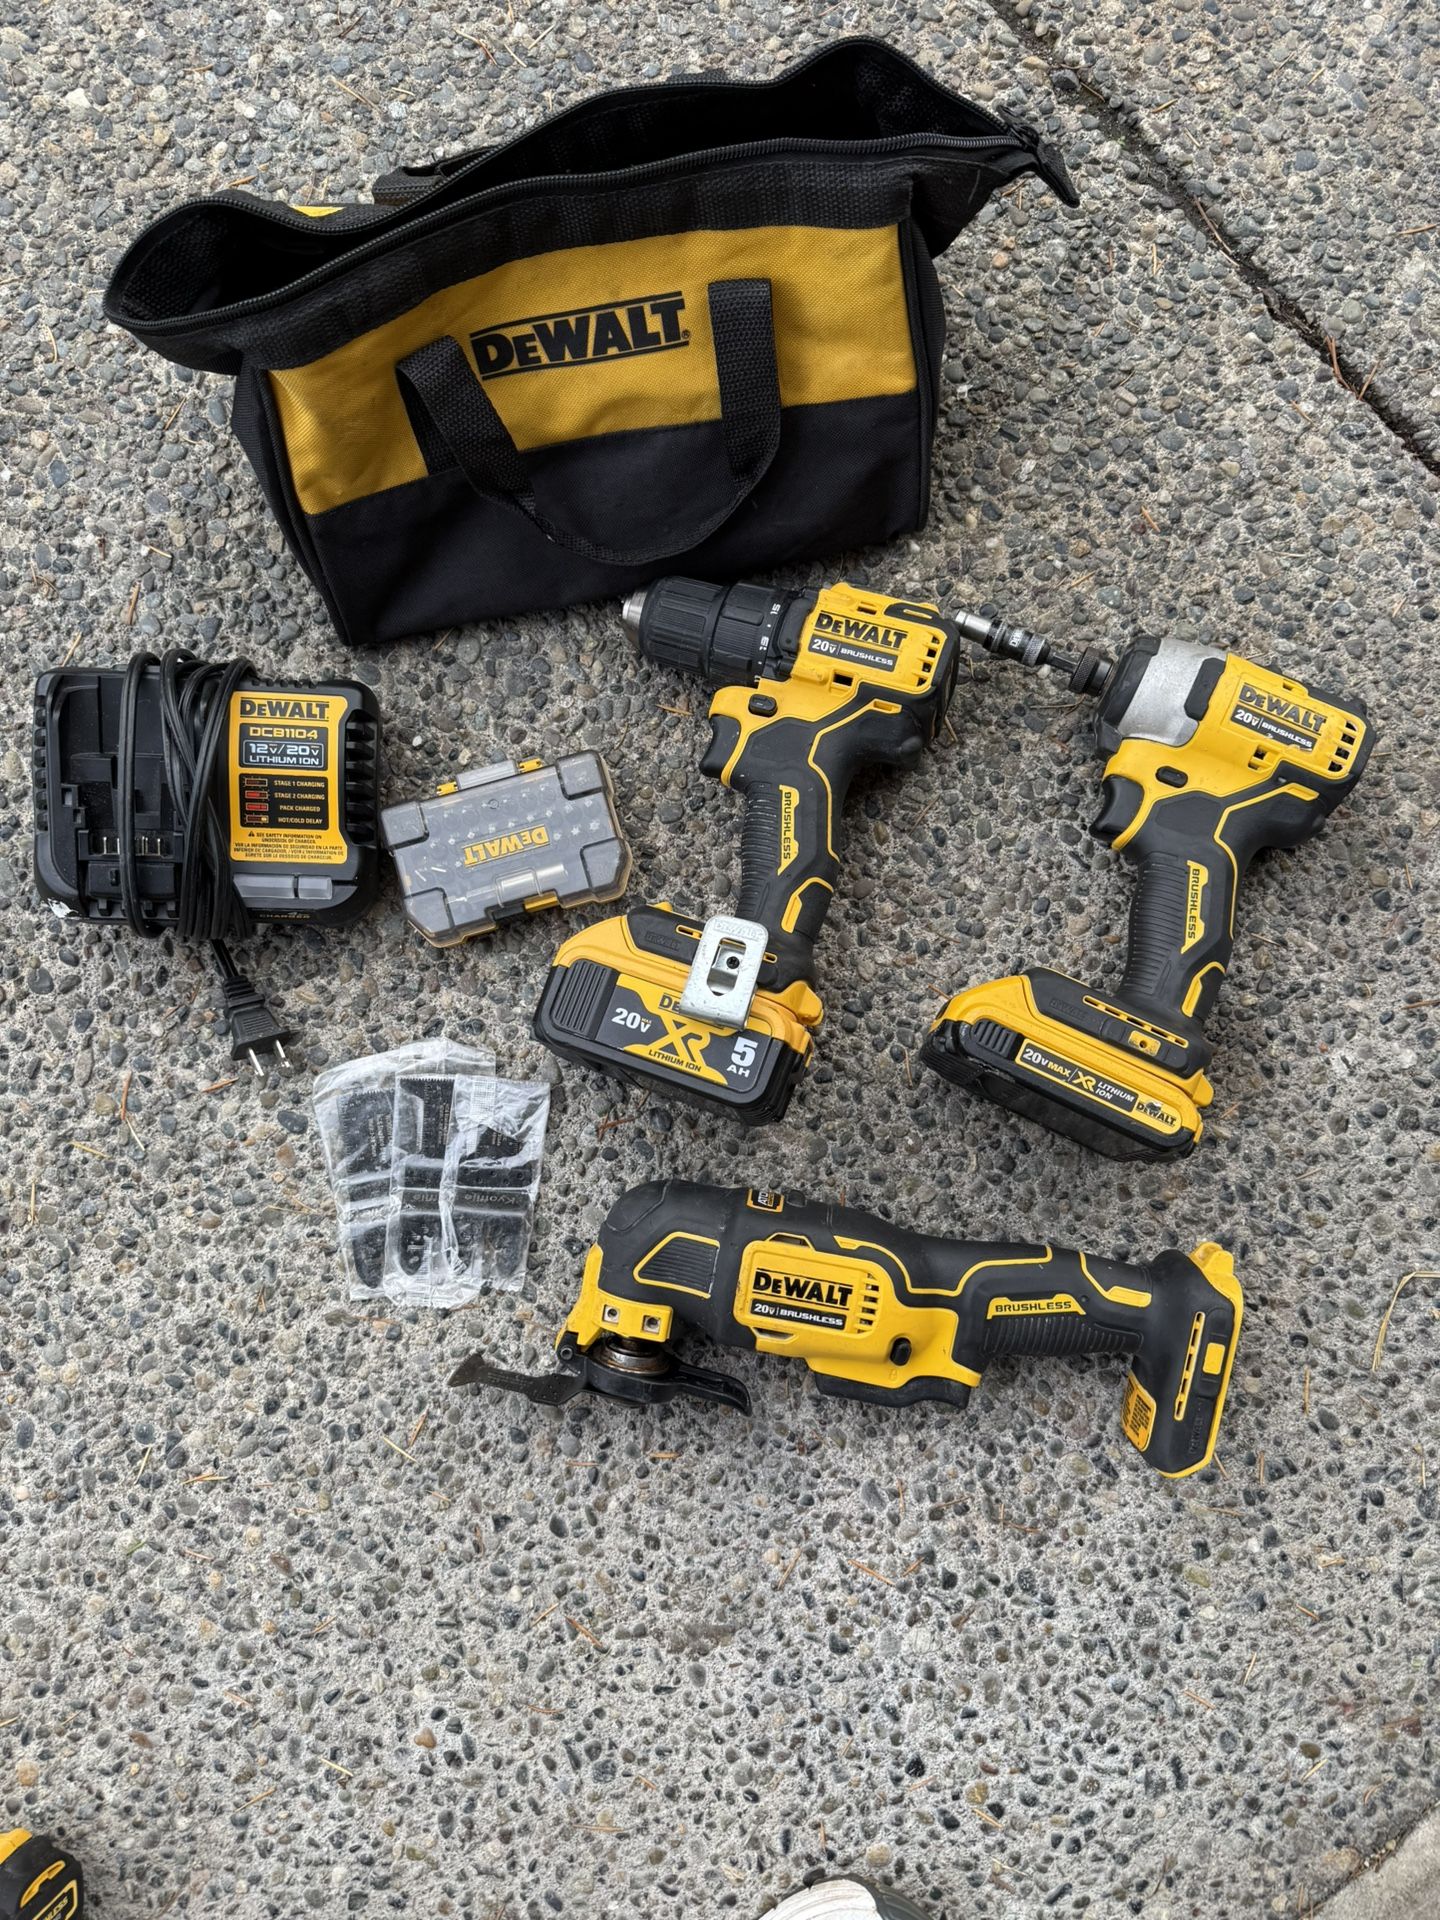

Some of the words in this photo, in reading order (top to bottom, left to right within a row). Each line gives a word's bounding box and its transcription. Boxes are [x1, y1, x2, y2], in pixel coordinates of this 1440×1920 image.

[814, 613, 908, 648] DEWALT
[840, 648, 893, 666] BRUSHLESS
[240, 699, 329, 720] DEWALT
[1238, 684, 1327, 733] DEWALT
[1262, 722, 1312, 748] BRUSHLESS
[250, 755, 296, 764] LITHIUM
[299, 757, 319, 765] ION
[296, 780, 325, 788] CHARGING
[783, 792, 791, 860] BRUSHLESS
[464, 826, 549, 866] DEWALT
[1188, 868, 1200, 939] BRUSHLESS
[648, 1050, 684, 1066] LITHIUM
[685, 1062, 702, 1072] ION
[730, 1036, 758, 1067] 5
[726, 1064, 750, 1078] AH
[1072, 1071, 1096, 1092] XR
[1097, 1081, 1135, 1102] LITHIUM
[1095, 1089, 1112, 1100] ION
[753, 1271, 853, 1306] DEWALT
[780, 1309, 843, 1326] BRUSHLESS
[995, 1301, 1072, 1313] BRUSHLESS
